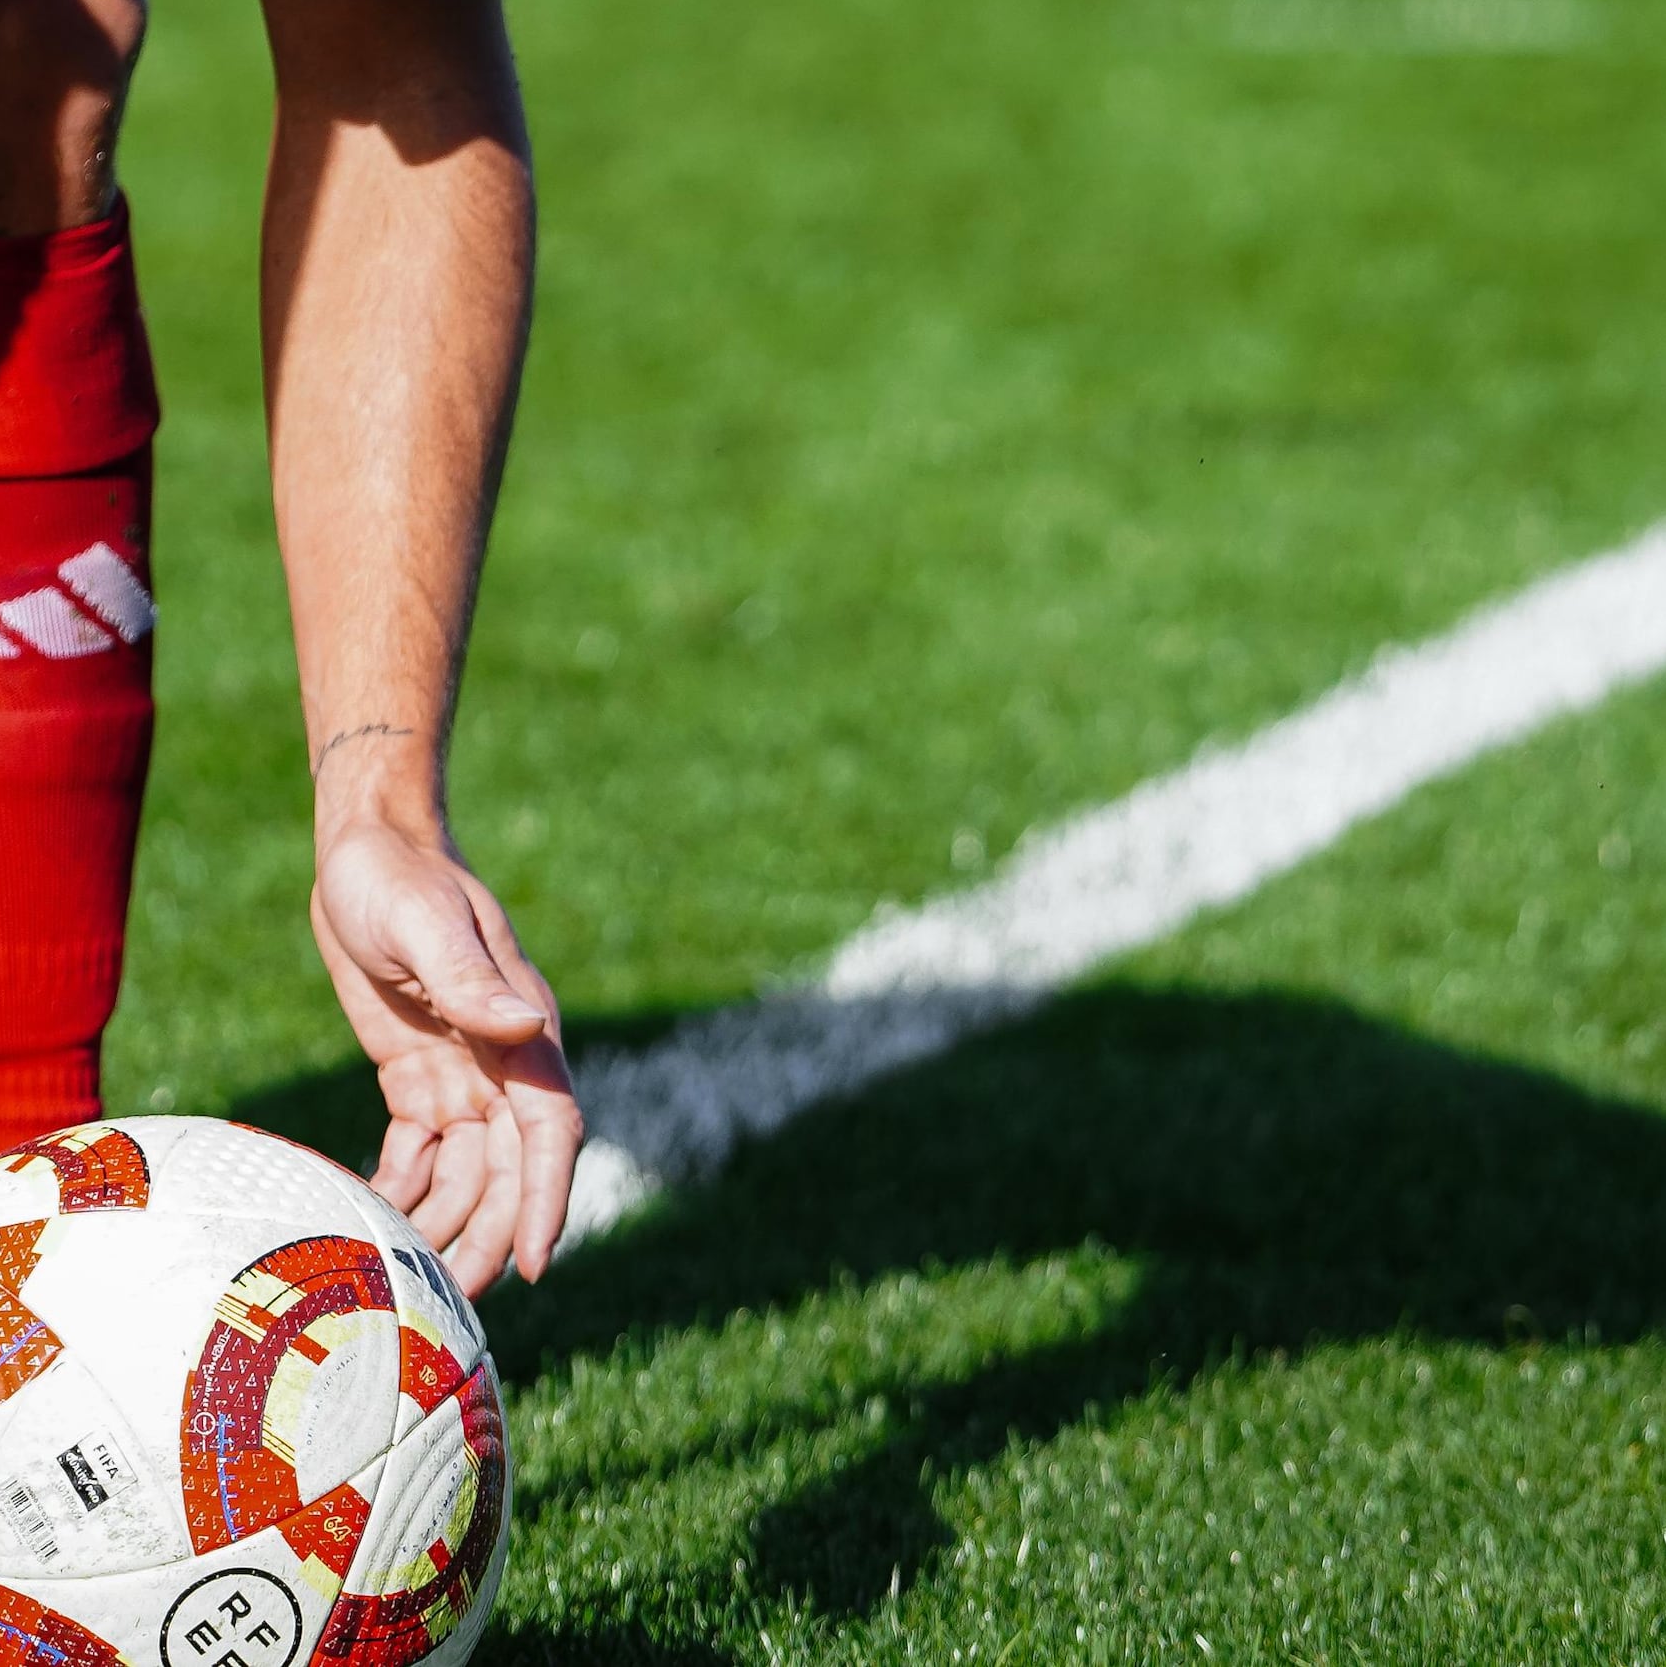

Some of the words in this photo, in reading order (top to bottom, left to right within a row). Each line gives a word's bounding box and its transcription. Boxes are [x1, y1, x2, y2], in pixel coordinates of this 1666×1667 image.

[65, 1452, 99, 1487] QUALITY
[85, 1484, 100, 1504] PRO
[93, 1443, 119, 1480] FIFA
